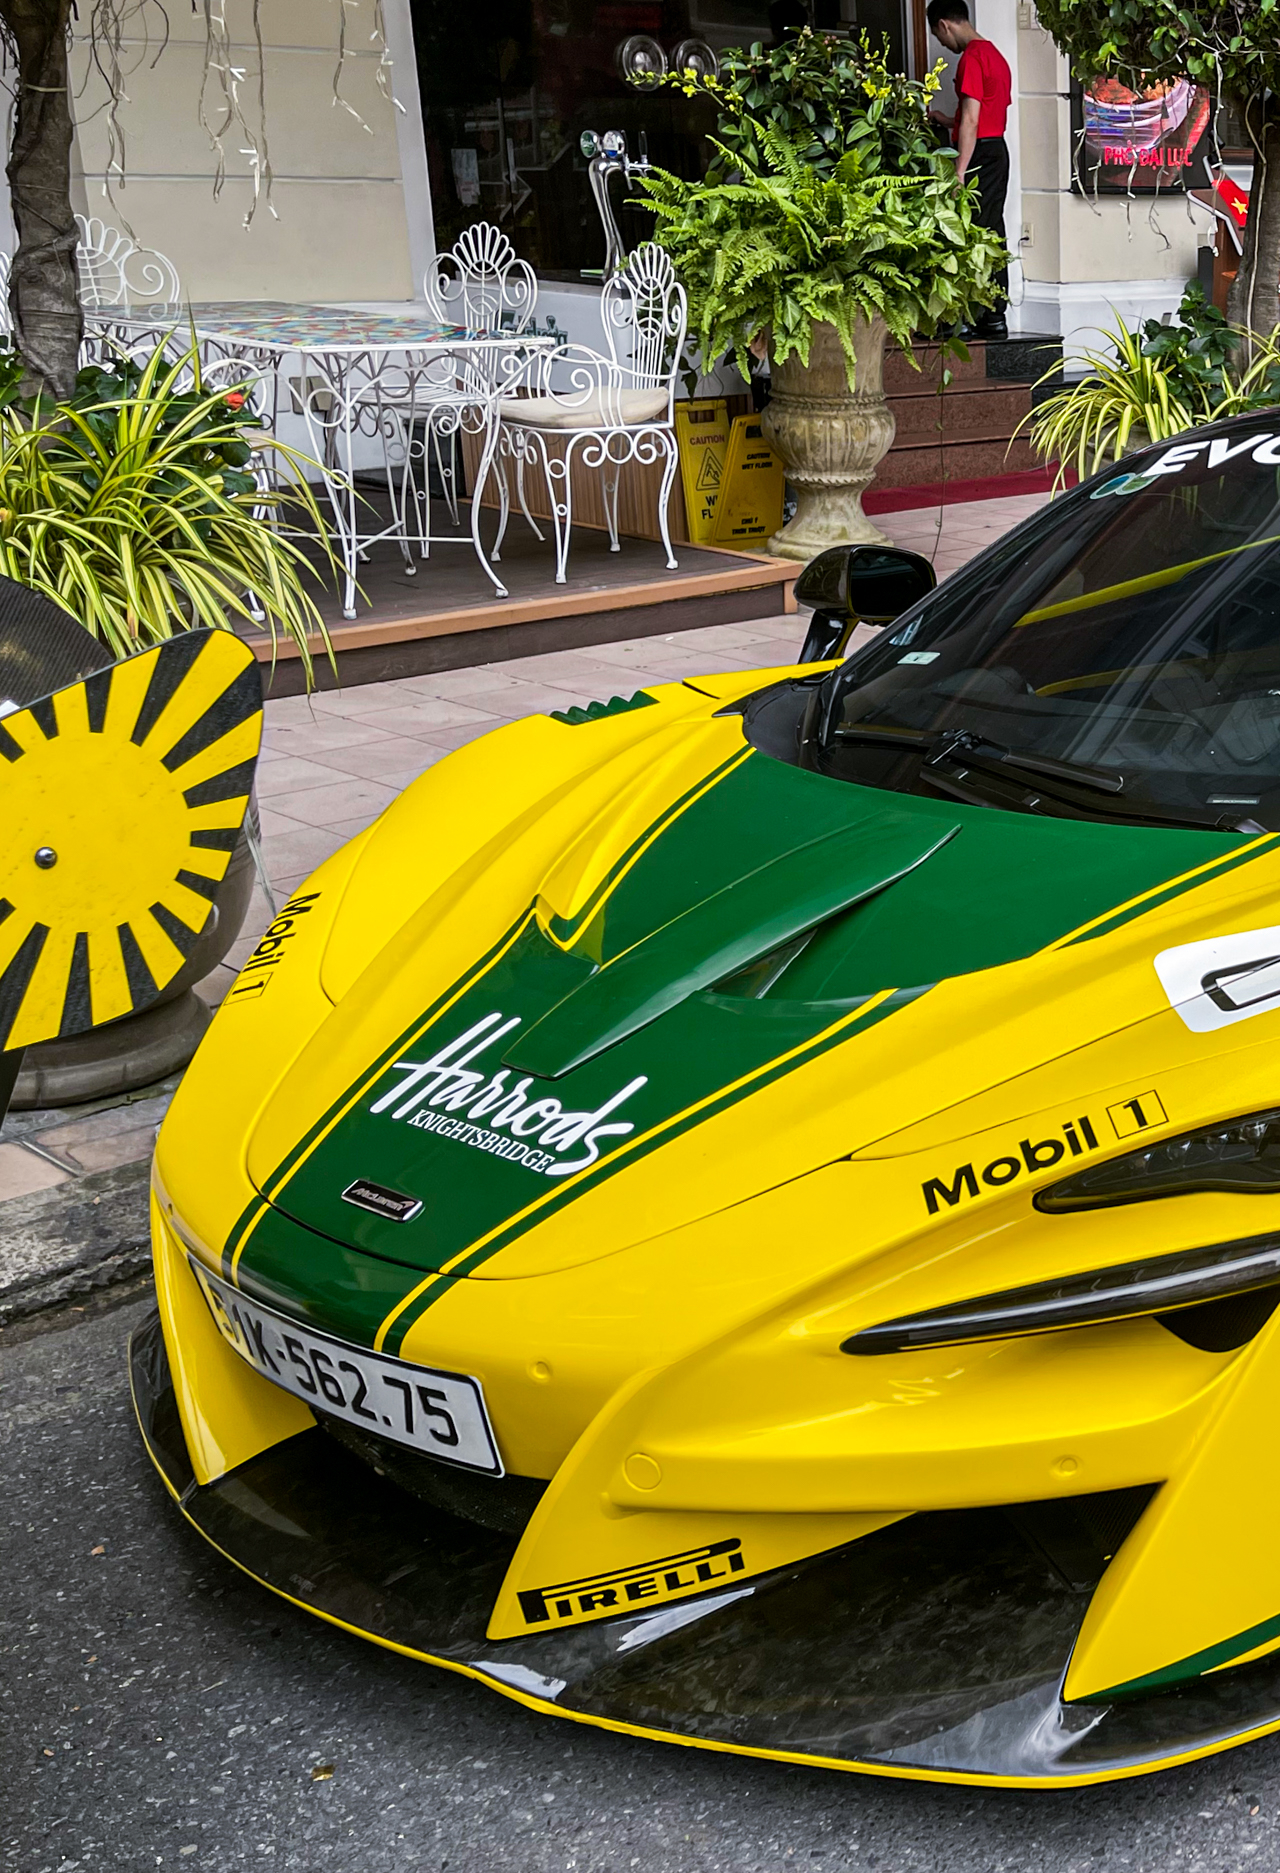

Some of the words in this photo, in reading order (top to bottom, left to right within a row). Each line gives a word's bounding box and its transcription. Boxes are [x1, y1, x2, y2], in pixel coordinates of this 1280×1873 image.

[690, 434, 725, 446] CAUTION
[242, 891, 323, 973] Mobil
[369, 1011, 649, 1176] Harrods
[406, 1108, 556, 1174] KNIGHTSBRIDGE
[921, 1115, 1100, 1215] Mobil
[1122, 1098, 1149, 1129] 1
[516, 1537, 746, 1625] PIRELLI
